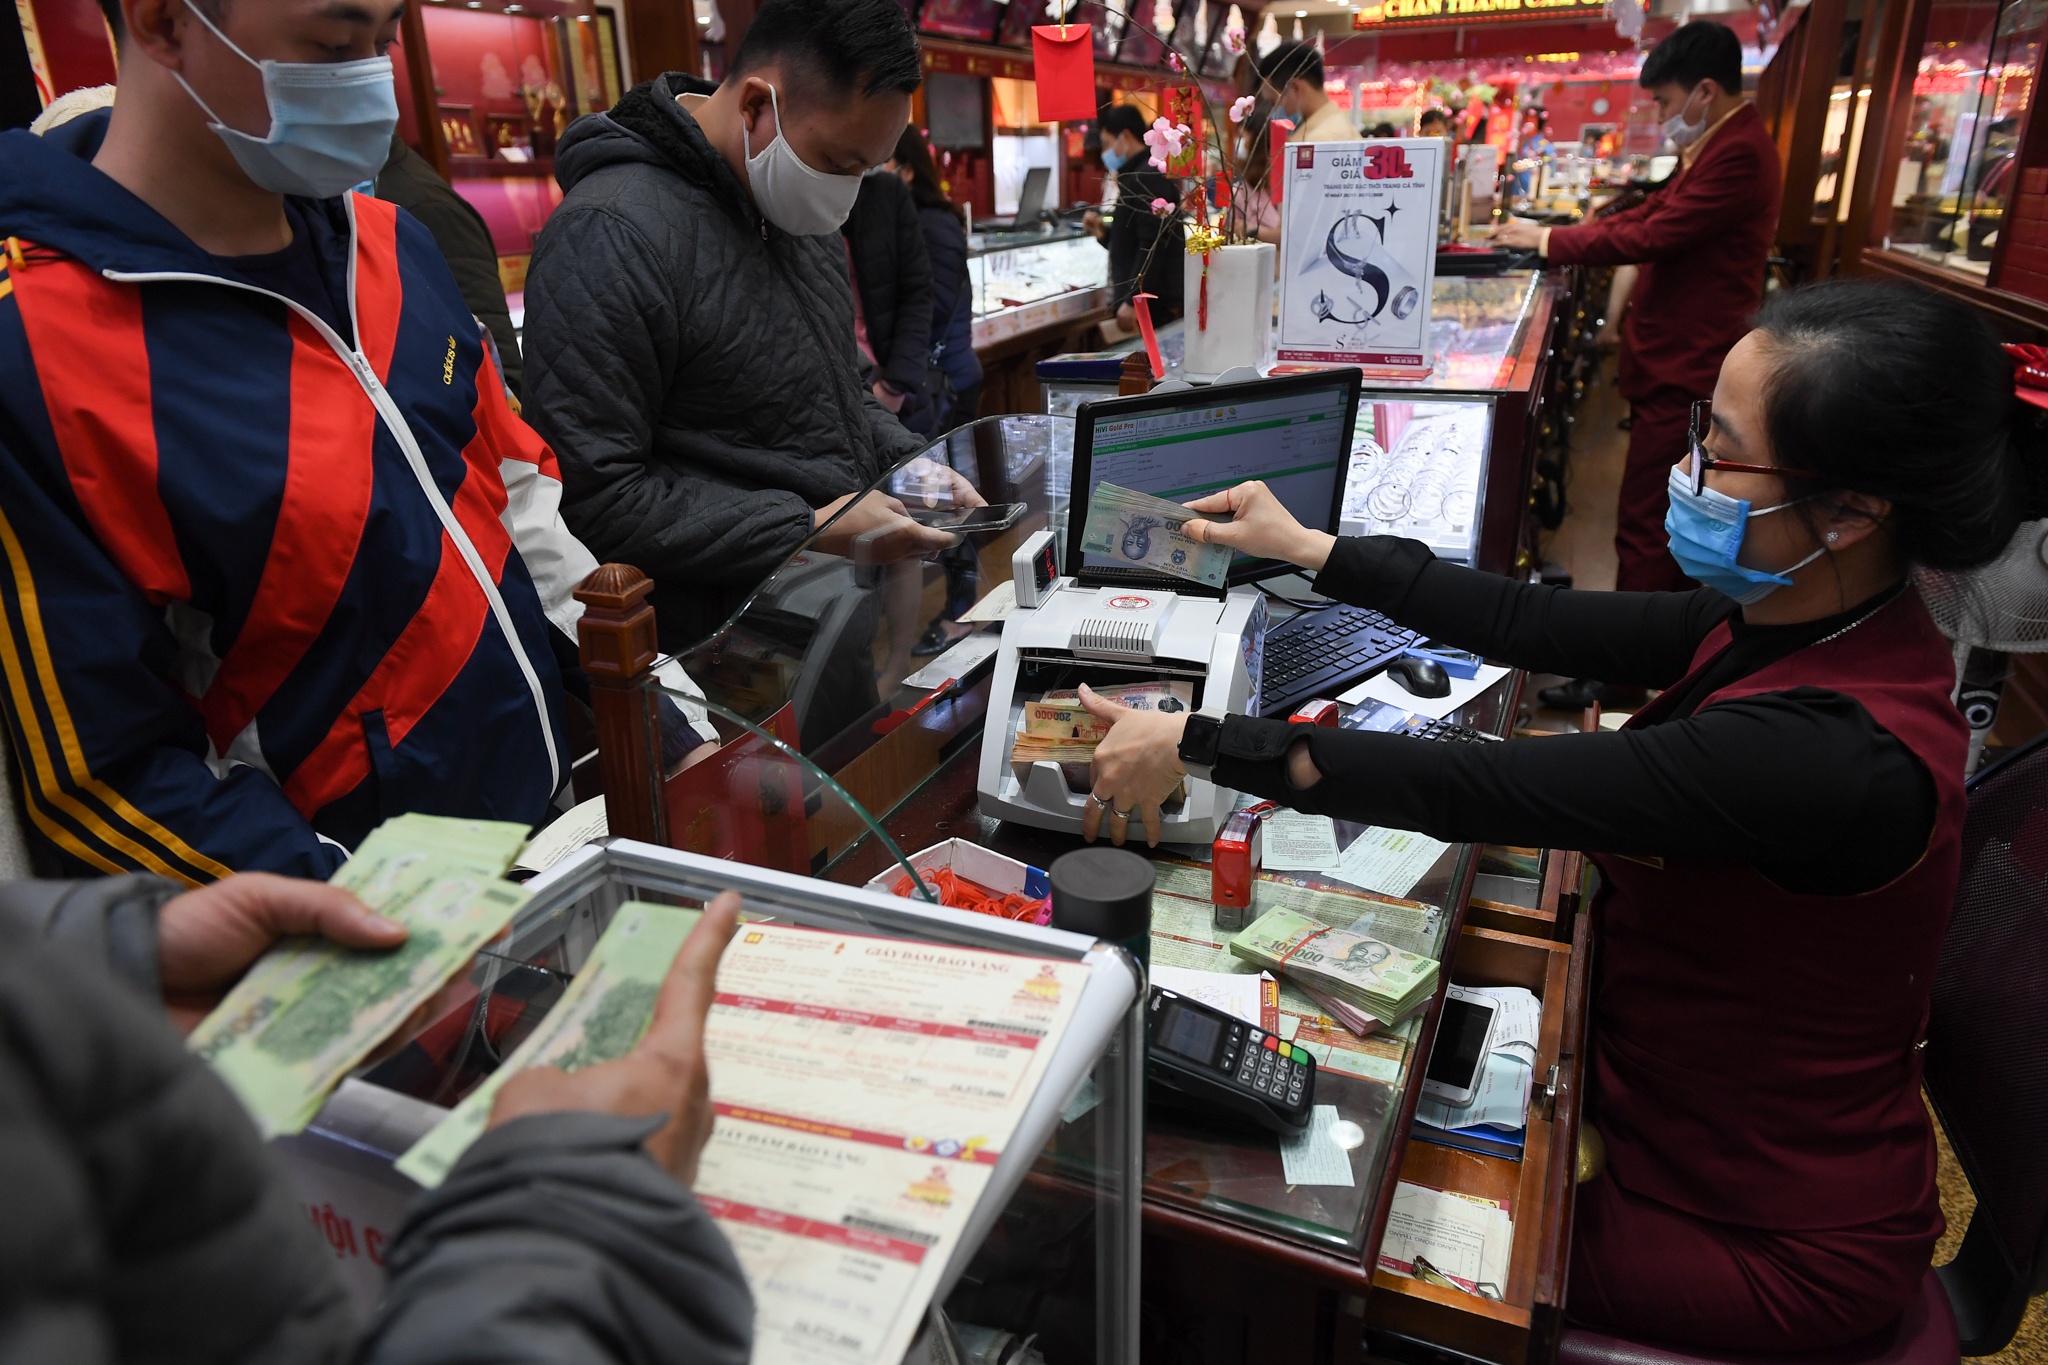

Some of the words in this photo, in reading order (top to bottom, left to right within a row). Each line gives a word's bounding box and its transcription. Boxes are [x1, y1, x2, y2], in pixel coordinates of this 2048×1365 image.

[1332, 154, 1362, 167] GIẢM
[1340, 168, 1360, 180] GIÁ
[443, 348, 456, 385] adidas
[1035, 710, 1071, 722] 200000
